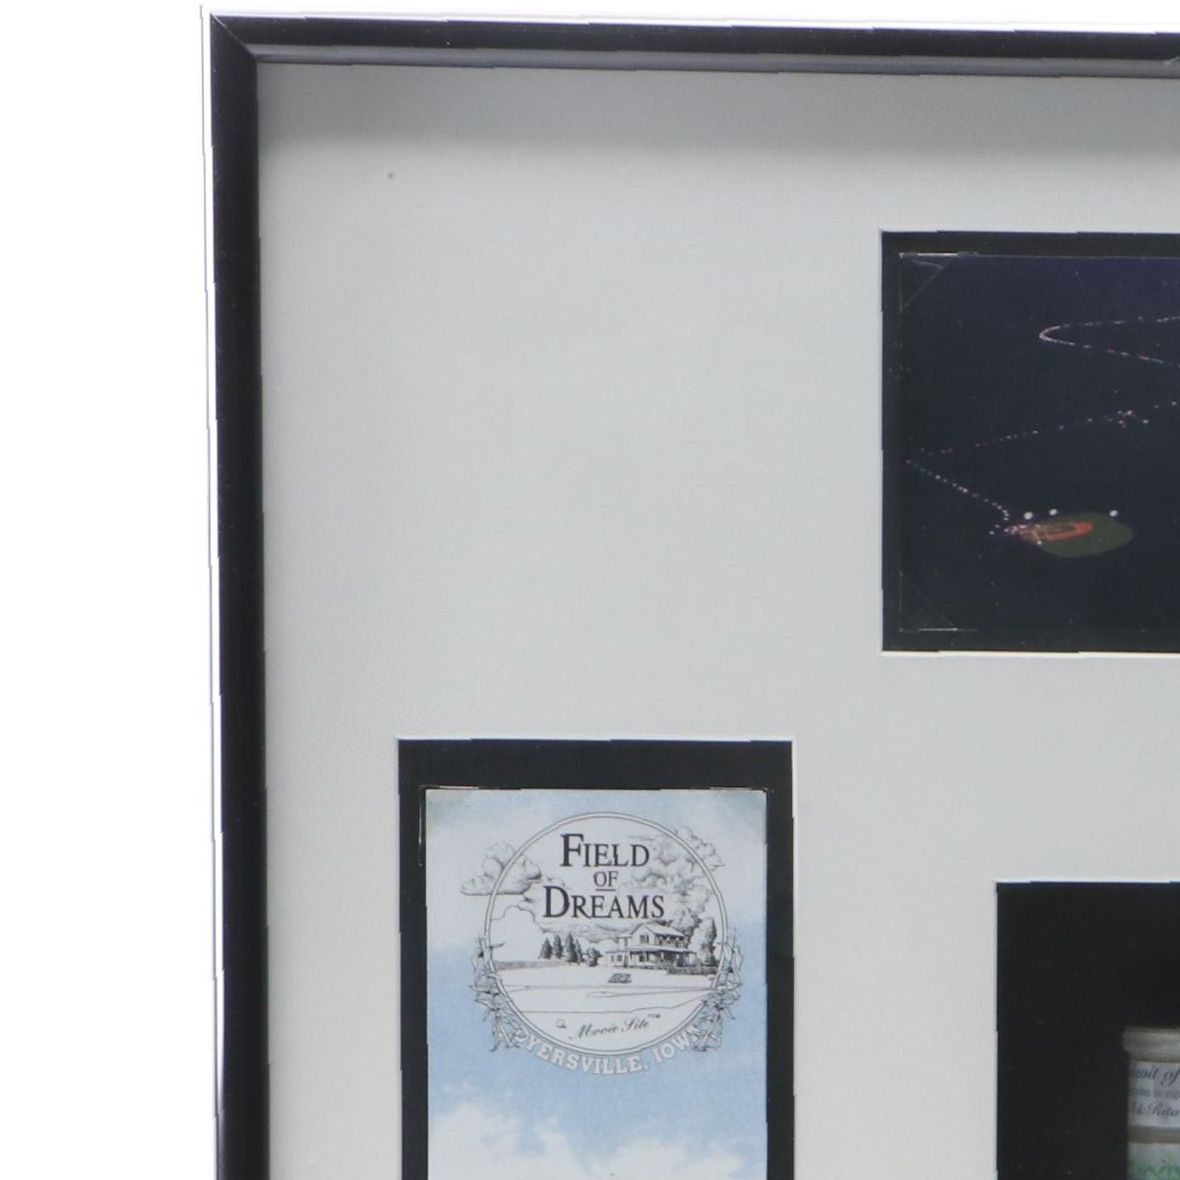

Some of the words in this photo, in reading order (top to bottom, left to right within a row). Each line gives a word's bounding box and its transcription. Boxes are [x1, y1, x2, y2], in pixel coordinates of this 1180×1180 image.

[559, 833, 651, 867] FIELD
[592, 870, 619, 888] OF
[543, 886, 665, 919] DREAMS
